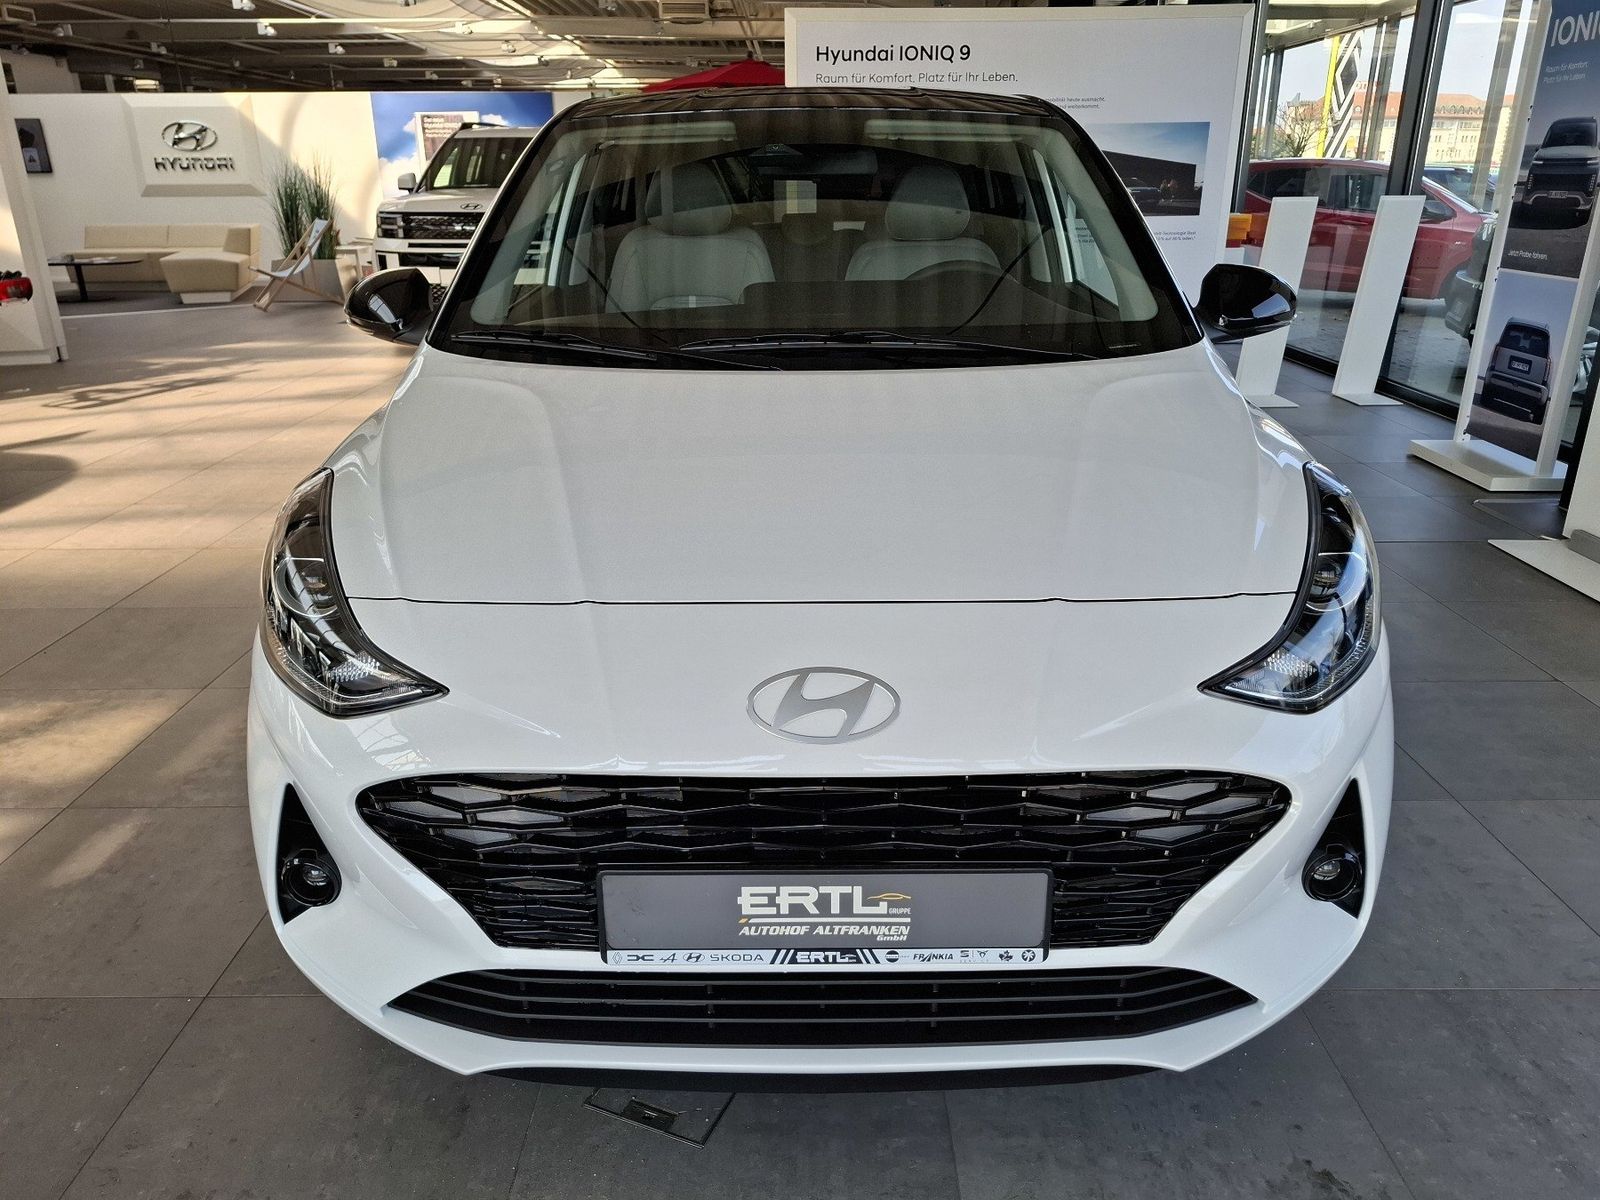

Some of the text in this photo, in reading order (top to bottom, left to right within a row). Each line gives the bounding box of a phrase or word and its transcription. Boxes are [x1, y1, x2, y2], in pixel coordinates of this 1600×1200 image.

[1551, 10, 1600, 47] IONI
[816, 44, 971, 65] Hyundai IONIQ 9
[815, 70, 1018, 84] Raum für Komfort. Platz für Ihr Leben.
[154, 157, 235, 171] HYUNDAI
[737, 885, 888, 915] ERTL
[888, 907, 912, 915] GRUPPE
[738, 925, 911, 936] AUTOHOF ALTFRANKEN
[876, 934, 908, 942] GmbH
[795, 951, 858, 963] ERTL
[912, 952, 954, 963] FRANKIA
